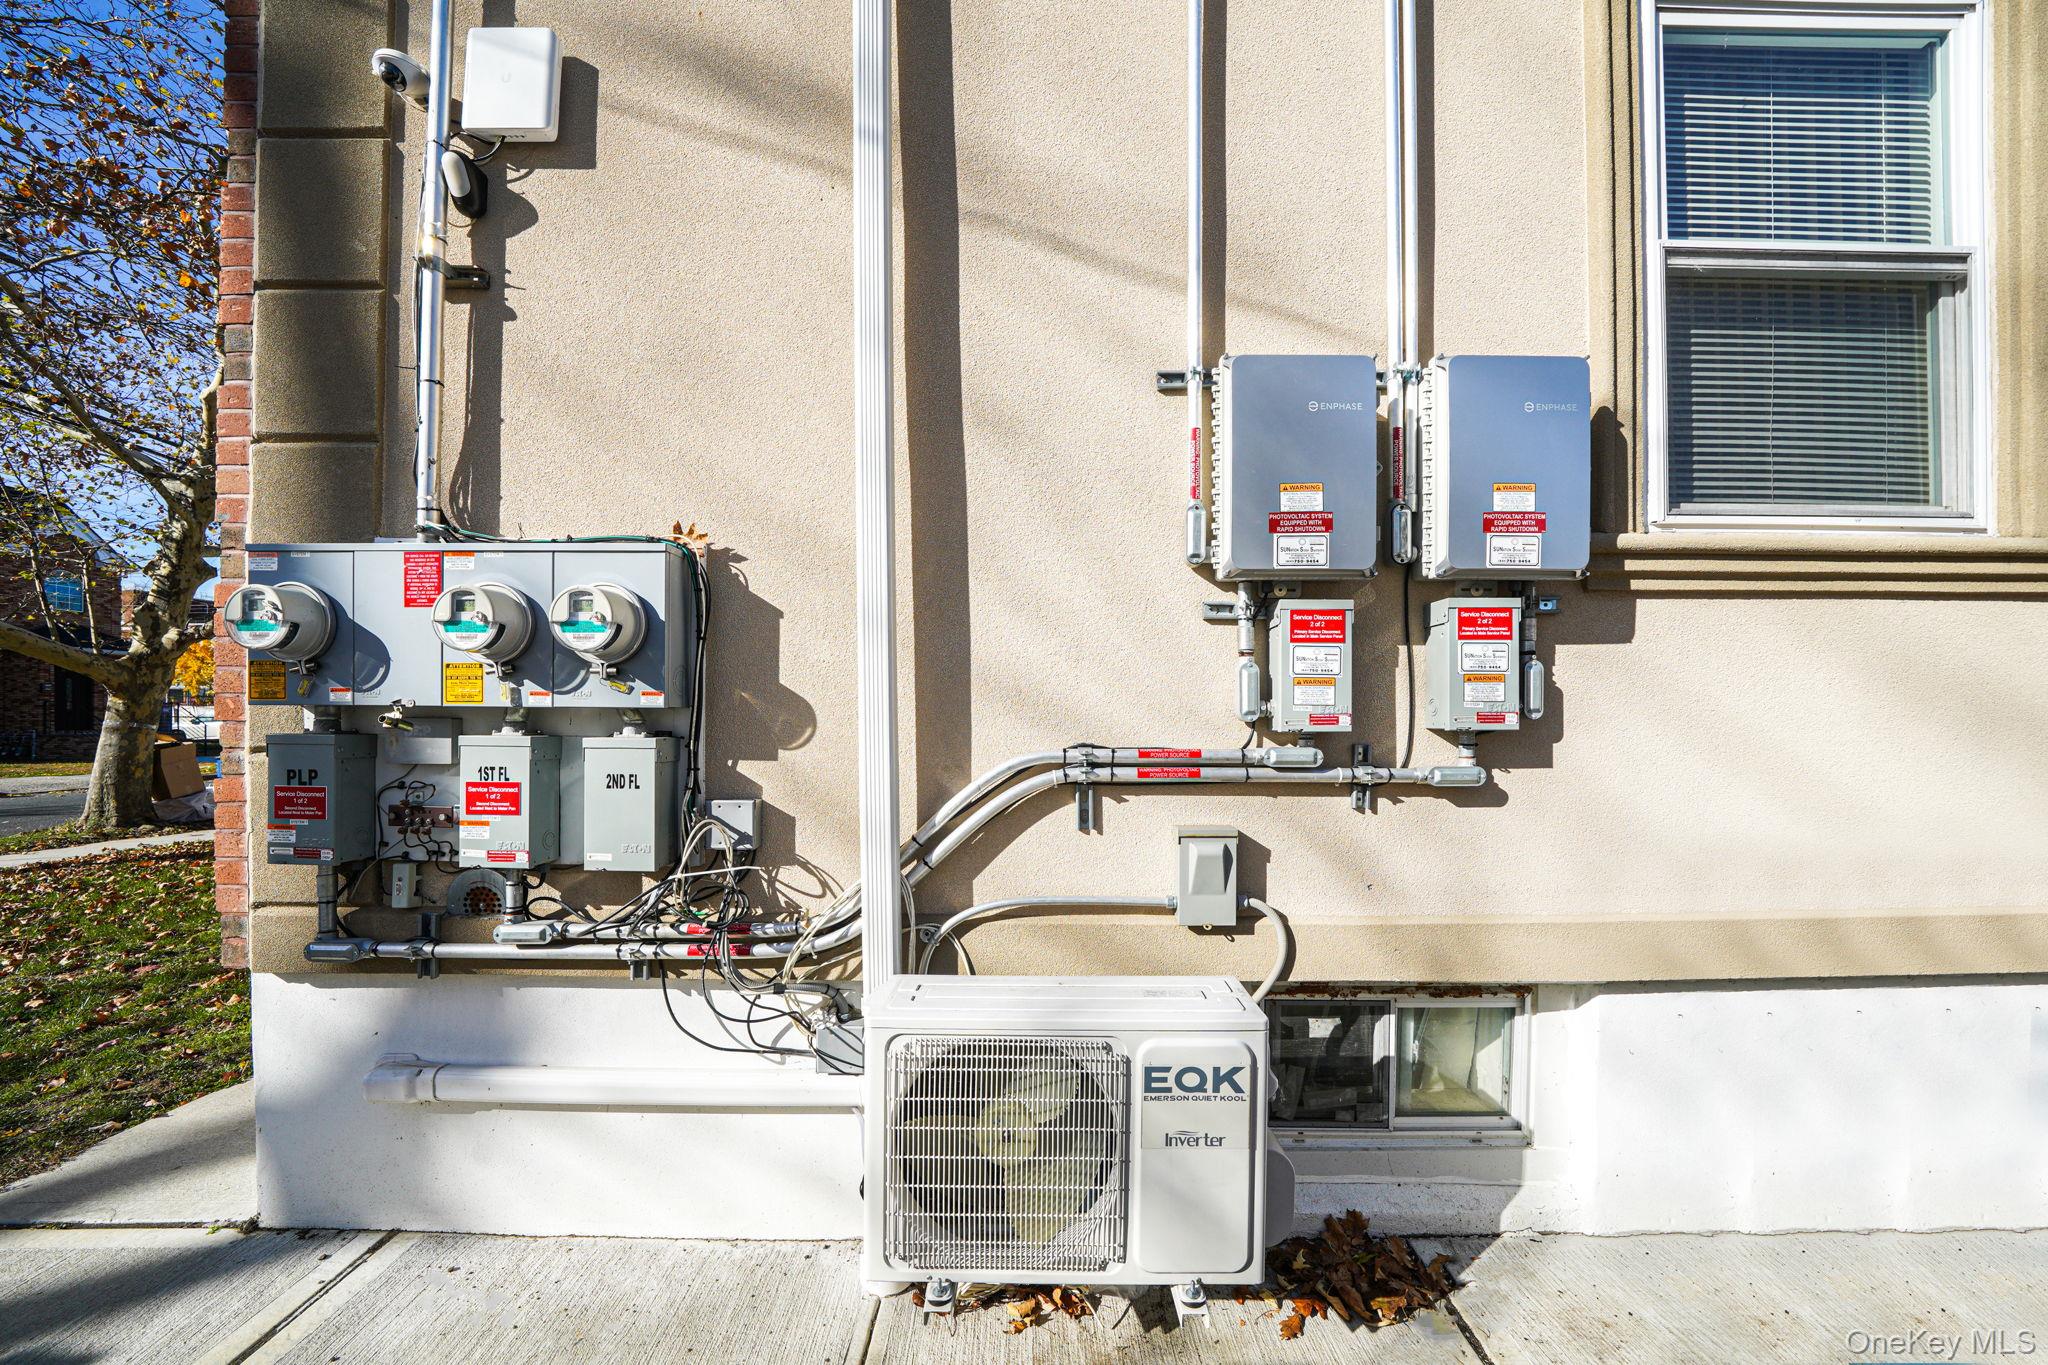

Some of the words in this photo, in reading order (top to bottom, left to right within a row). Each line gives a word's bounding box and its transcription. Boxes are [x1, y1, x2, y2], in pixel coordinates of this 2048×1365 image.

[1320, 402, 1364, 411] ENPHASE
[1535, 403, 1578, 412] ENPHASE
[286, 768, 319, 786] PLP
[478, 766, 496, 782] 1ST
[498, 766, 510, 782] FL
[606, 773, 626, 790] 2ND
[628, 773, 640, 790] FL
[621, 844, 652, 854] EATON
[1143, 1066, 1246, 1094] EQK
[1164, 1132, 1226, 1147] Inverter
